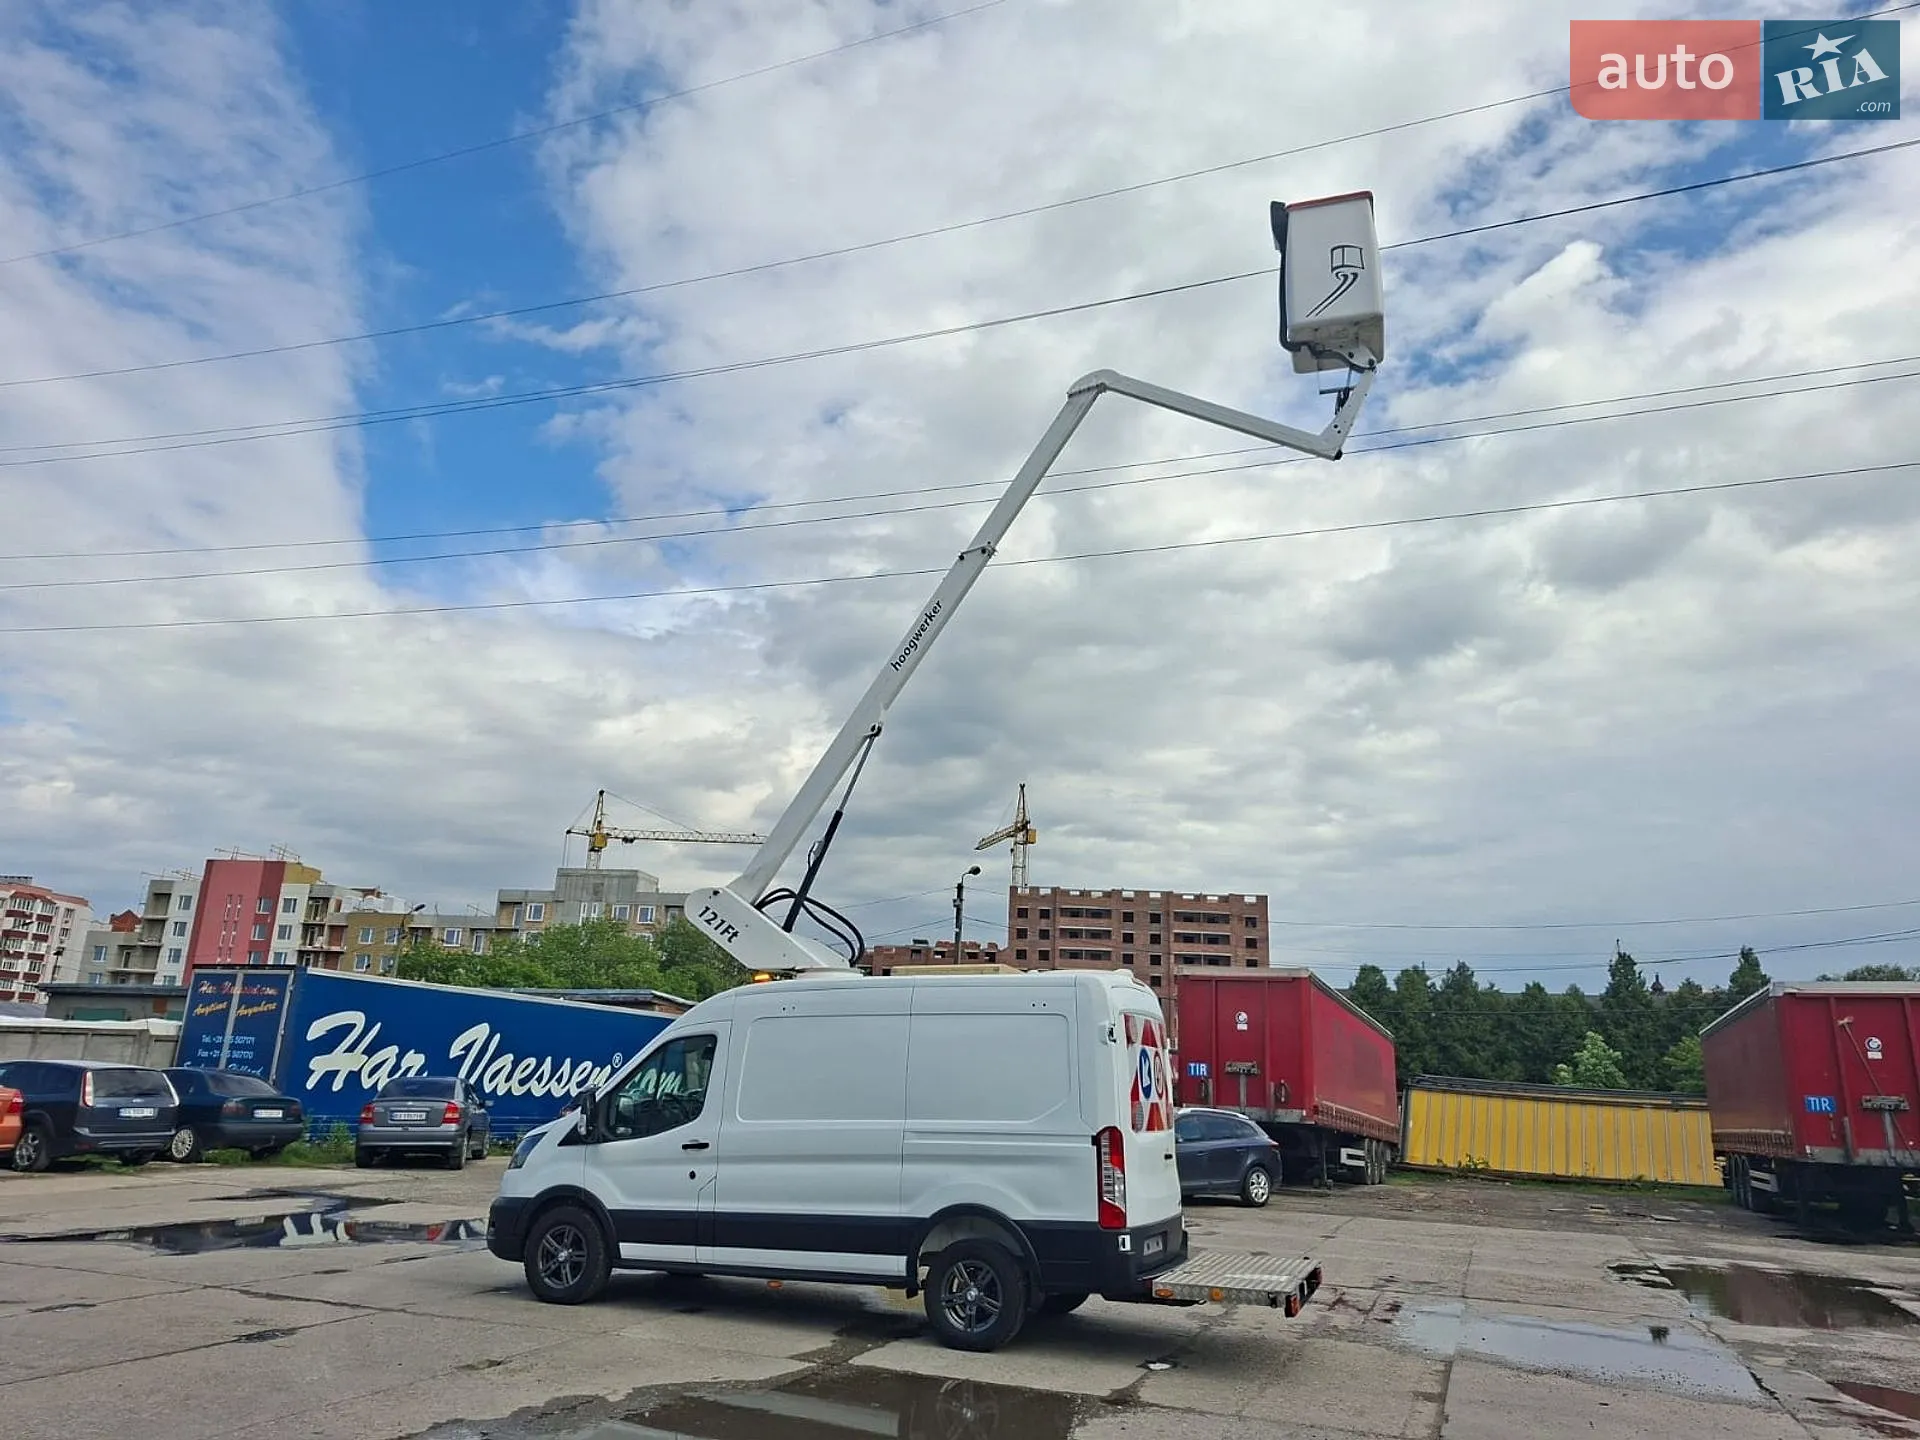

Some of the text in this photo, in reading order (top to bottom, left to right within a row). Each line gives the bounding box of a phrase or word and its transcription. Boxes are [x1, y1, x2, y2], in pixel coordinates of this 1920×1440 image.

[890, 600, 942, 672] hoogwerker
[698, 905, 740, 943] 121Ft
[306, 1010, 429, 1092] Har
[1188, 1063, 1208, 1077] TIR
[1806, 1096, 1832, 1112] TIR
